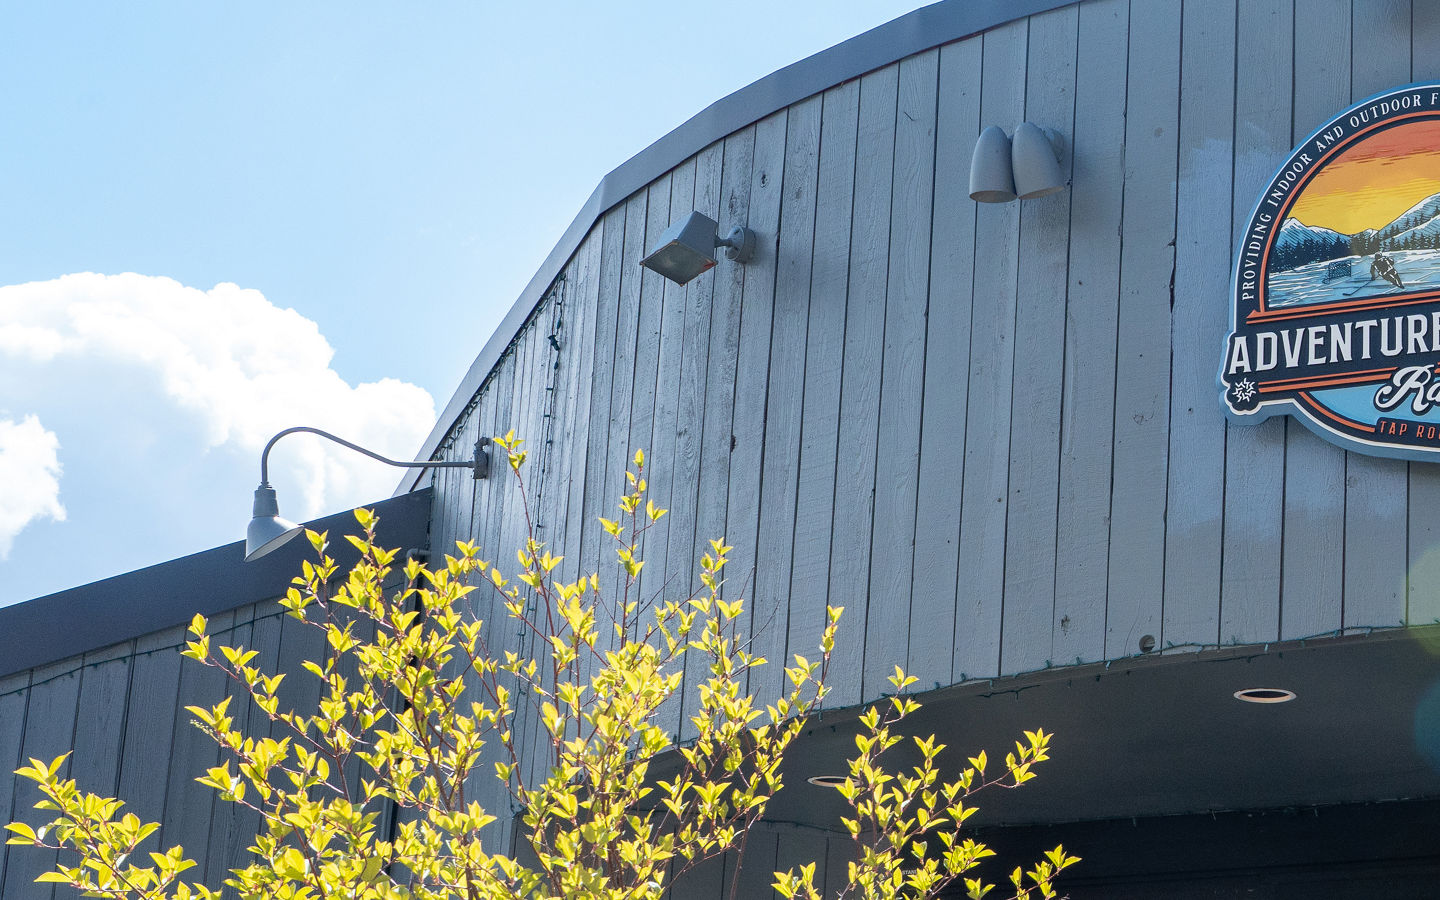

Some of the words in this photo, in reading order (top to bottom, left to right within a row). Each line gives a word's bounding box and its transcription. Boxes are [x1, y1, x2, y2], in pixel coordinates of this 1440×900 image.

[1242, 213, 1271, 300] PROVIDING
[1267, 154, 1312, 207] INDOOR
[1315, 125, 1344, 152] AND
[1349, 94, 1421, 128] OUTDOOR
[1379, 420, 1408, 436] TAP
